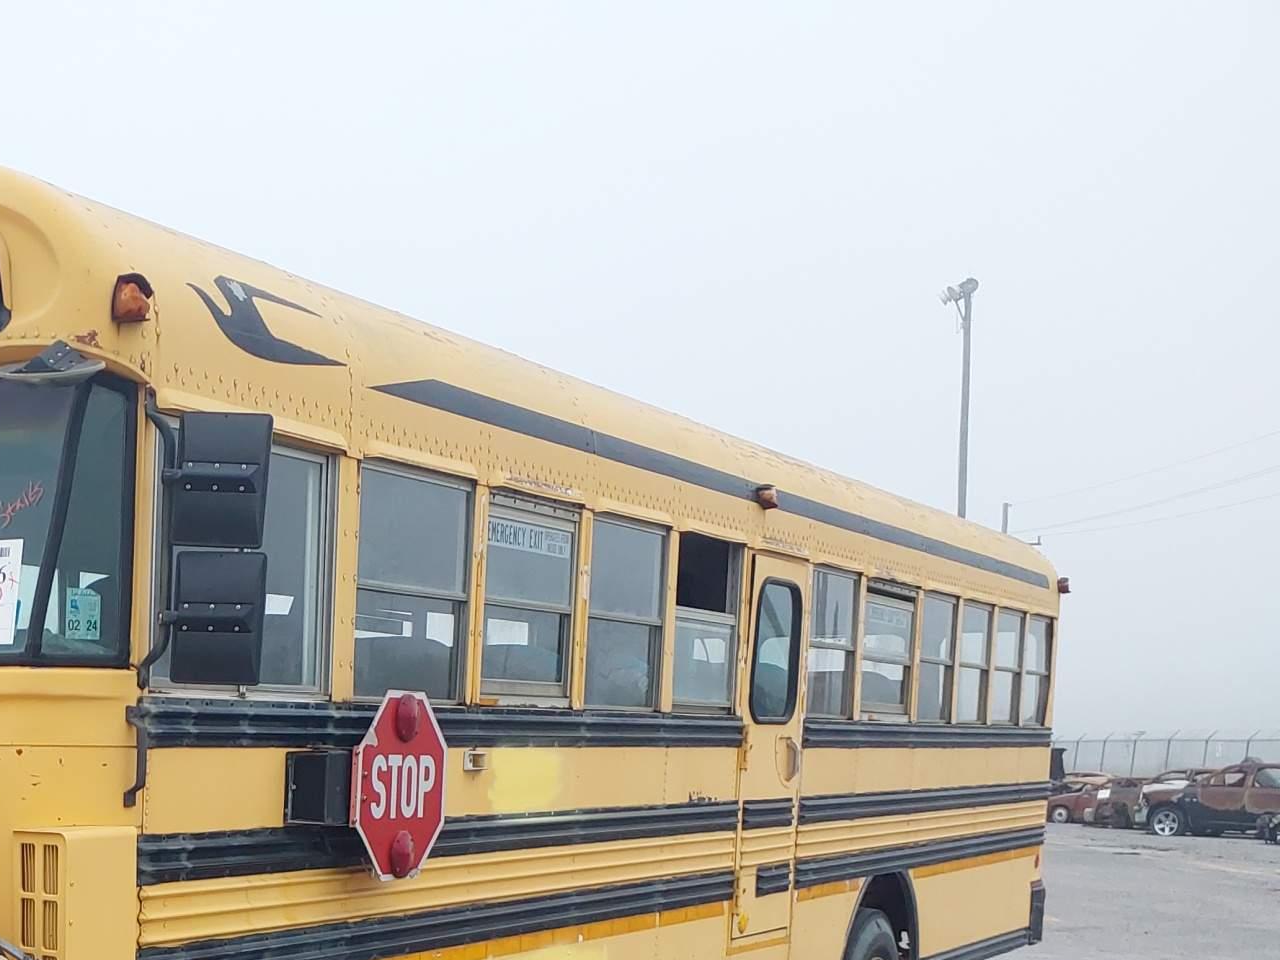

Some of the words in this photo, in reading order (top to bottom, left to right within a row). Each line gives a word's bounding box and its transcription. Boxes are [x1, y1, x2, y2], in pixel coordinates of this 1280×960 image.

[488, 520, 527, 547] EMERGENCY
[529, 528, 544, 551] EXIT
[68, 619, 81, 631] 02
[86, 619, 97, 631] 24
[370, 754, 436, 820] STOP
